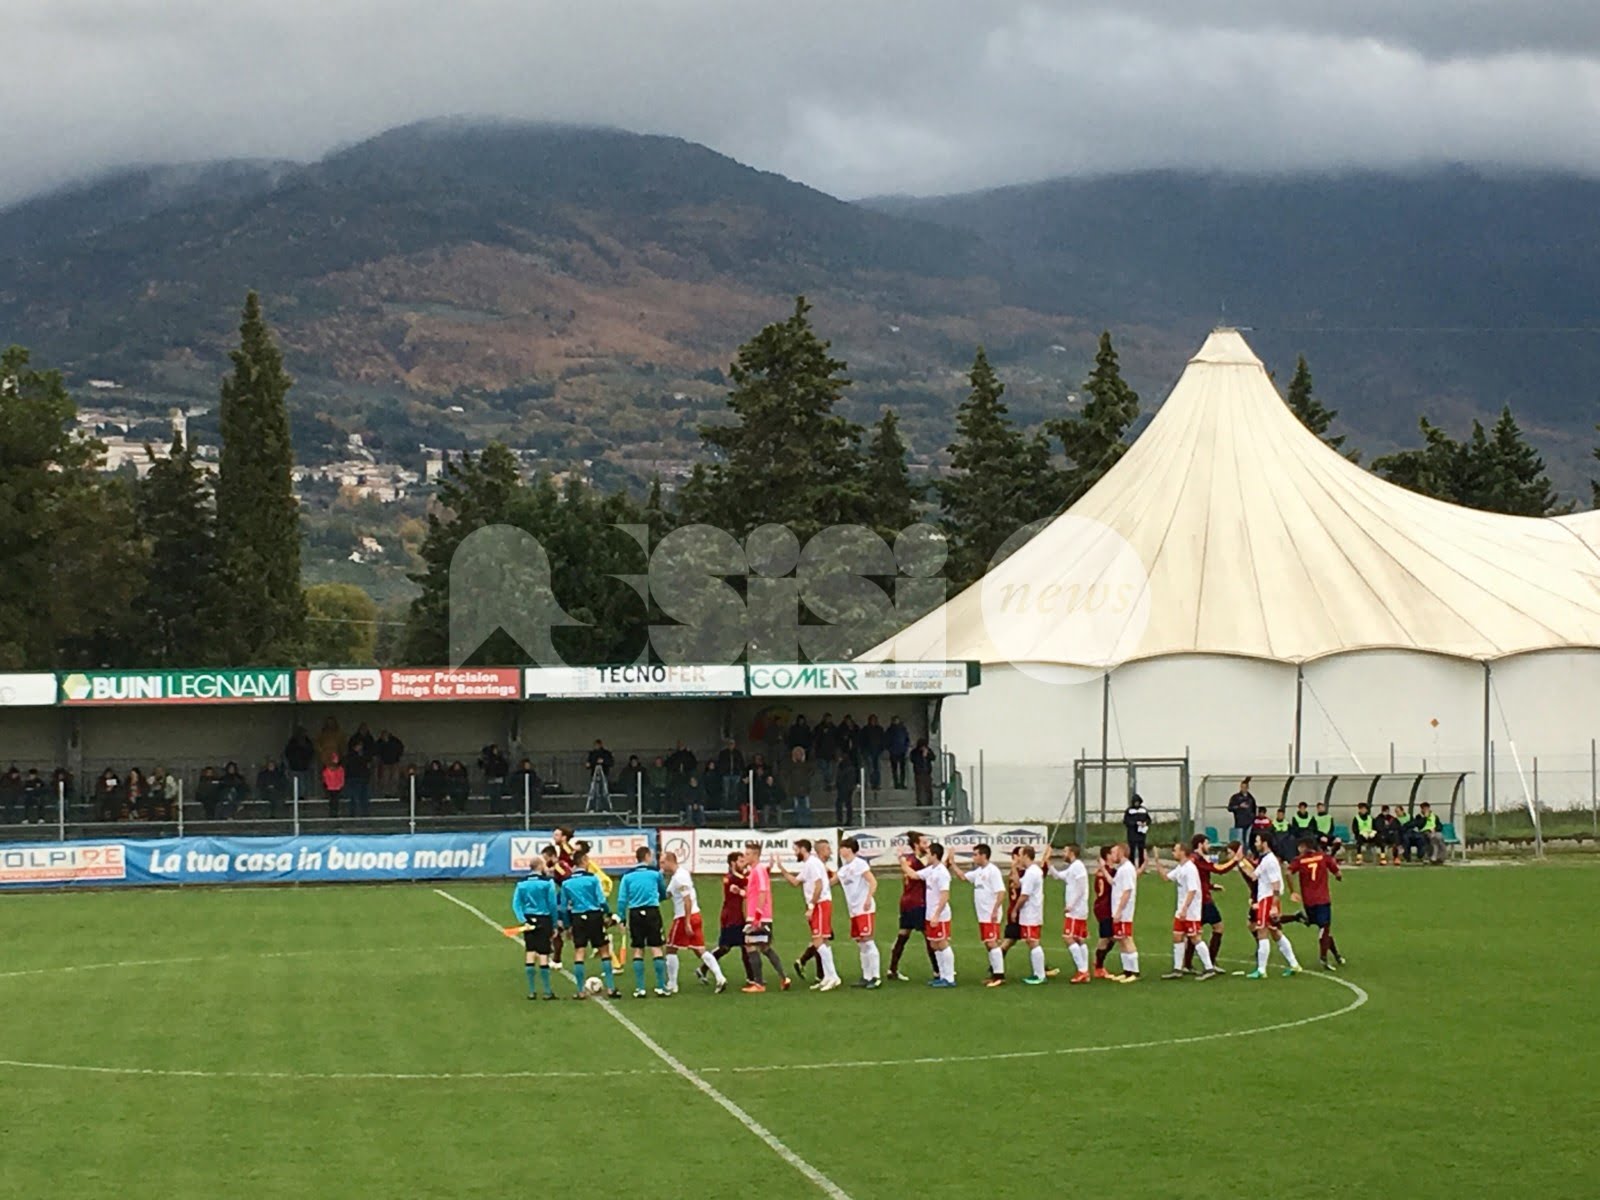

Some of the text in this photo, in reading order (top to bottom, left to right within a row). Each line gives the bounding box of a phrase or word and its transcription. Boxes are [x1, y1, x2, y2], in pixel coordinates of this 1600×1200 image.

[391, 671, 498, 684] Super Precision
[597, 666, 706, 684] TECNOFER
[93, 674, 289, 698] BUINI LEGNAMI
[391, 683, 516, 697] Rings for Bearings
[944, 836, 994, 846] ROSETTI
[996, 835, 1047, 846] ROSETTI
[150, 848, 180, 873] La
[186, 850, 230, 872] tua
[234, 850, 293, 872] casa
[297, 846, 322, 871] in
[327, 846, 408, 871] buone
[413, 842, 486, 869] mani!
[1307, 862, 1318, 881] 7
